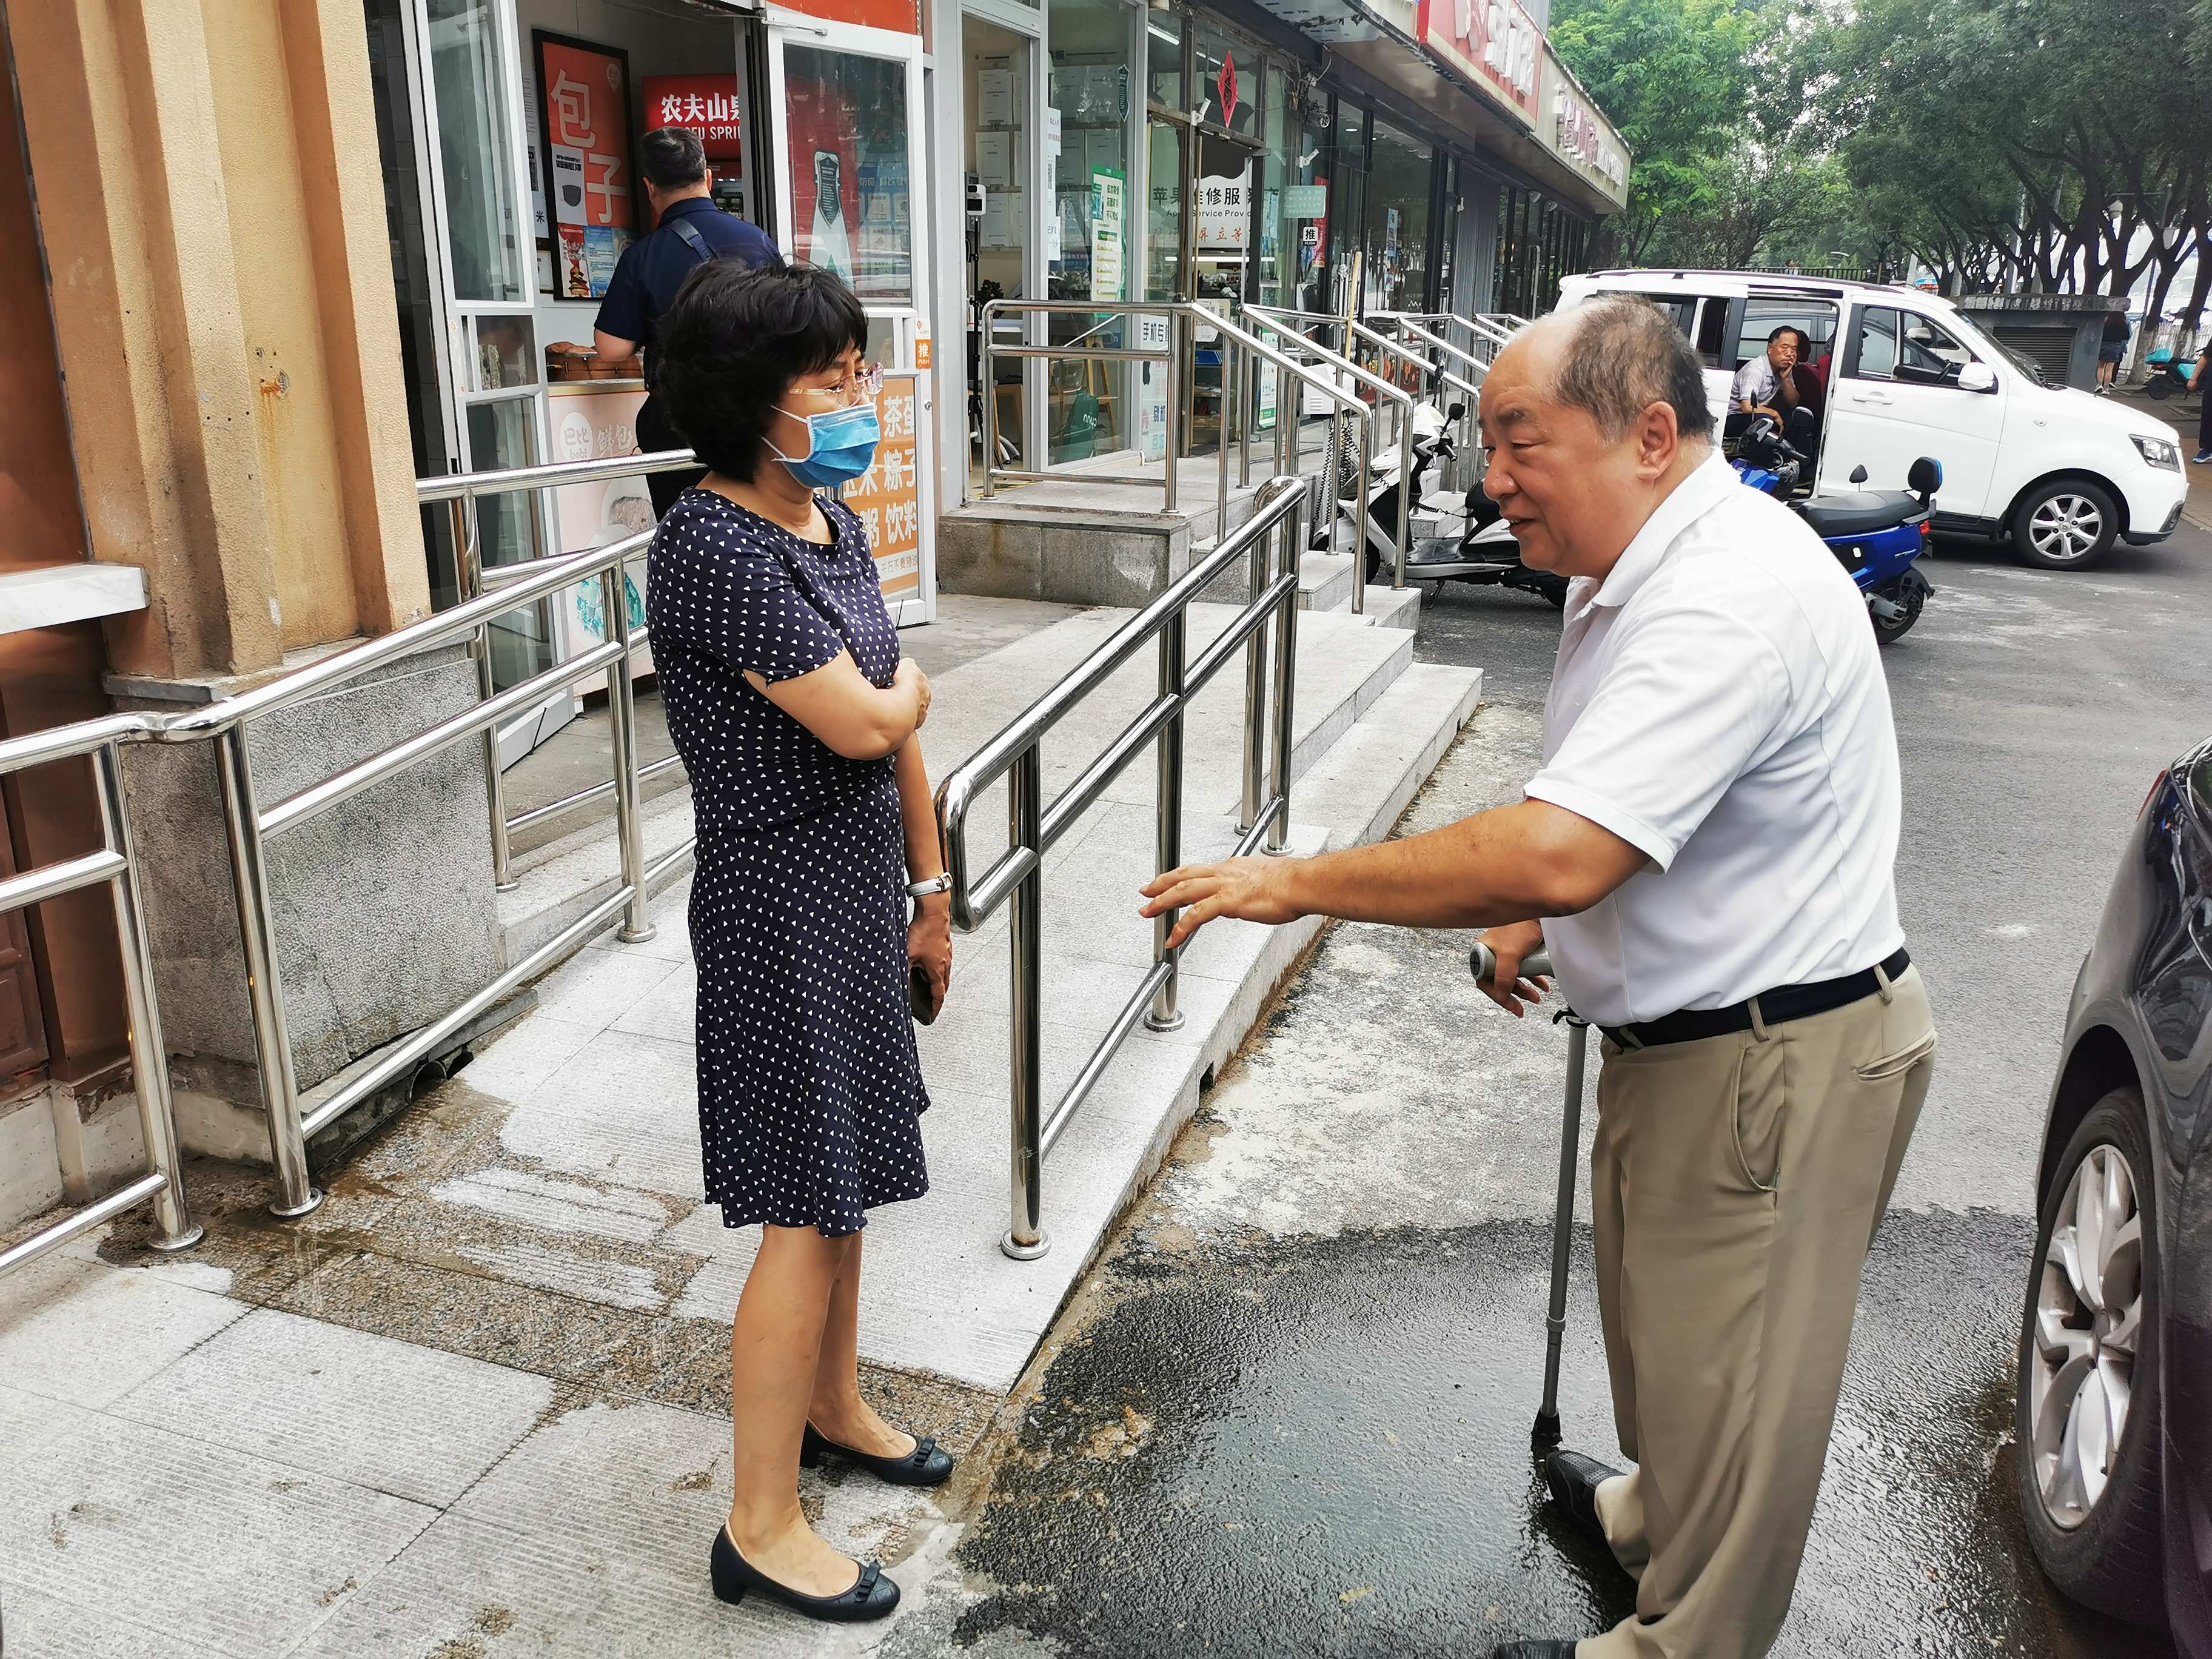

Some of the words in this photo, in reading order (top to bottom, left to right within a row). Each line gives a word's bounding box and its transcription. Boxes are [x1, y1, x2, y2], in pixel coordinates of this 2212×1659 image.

[551, 69, 627, 224] 包子
[1305, 229, 1315, 240] 推
[918, 343, 930, 357] 推
[564, 427, 589, 446] 巴比
